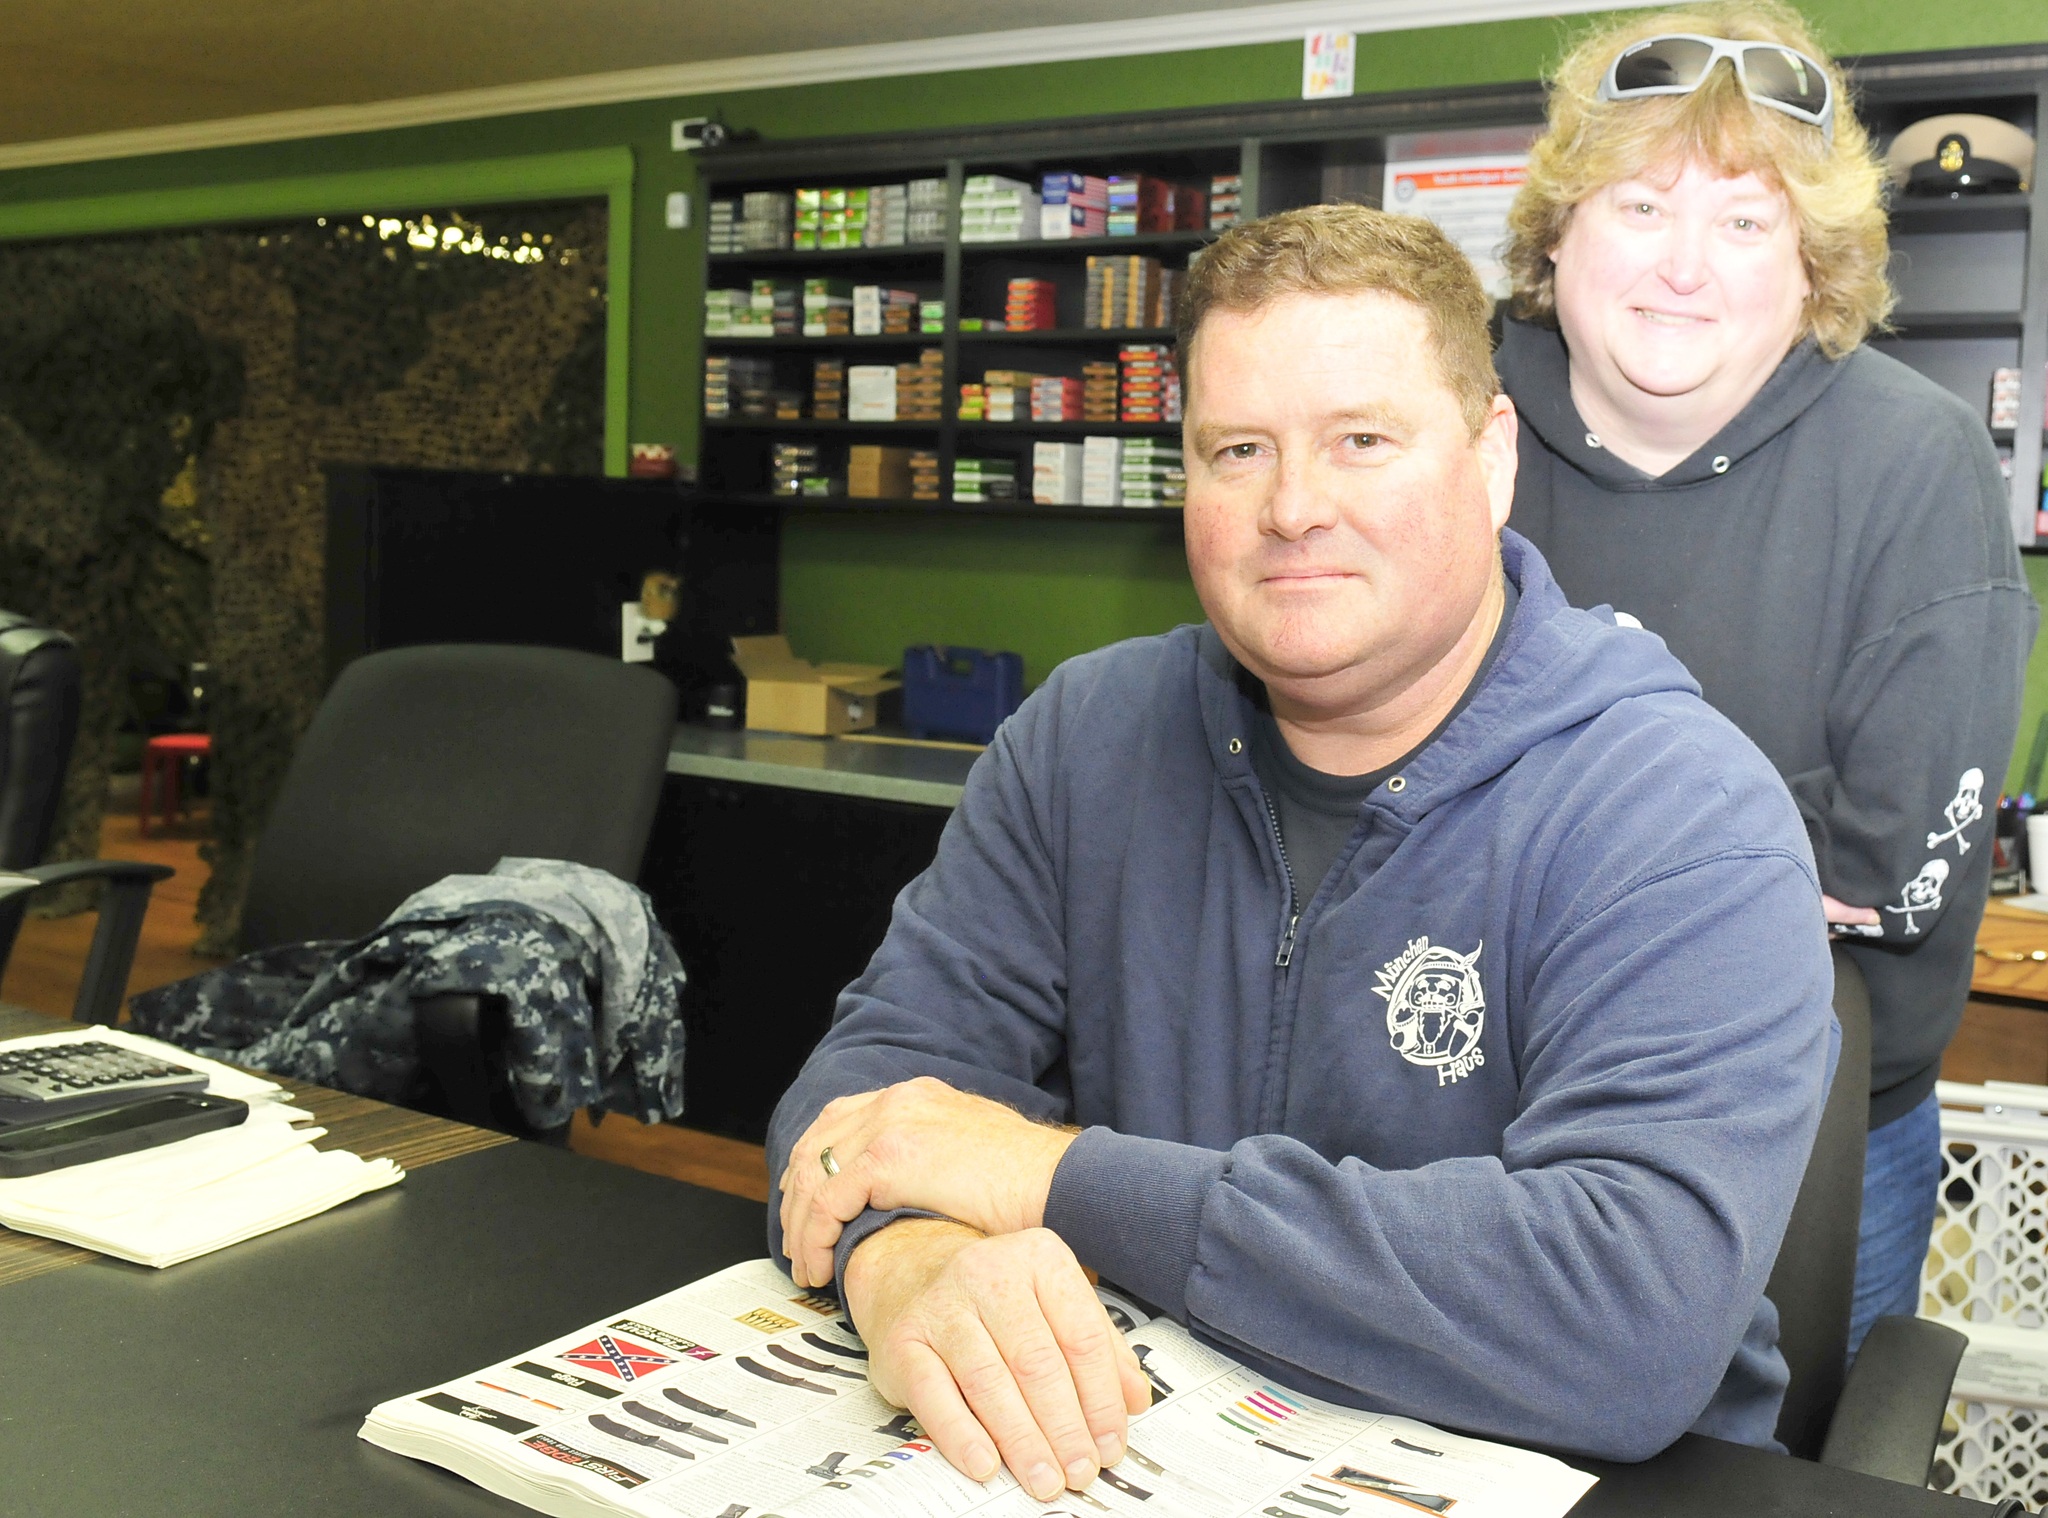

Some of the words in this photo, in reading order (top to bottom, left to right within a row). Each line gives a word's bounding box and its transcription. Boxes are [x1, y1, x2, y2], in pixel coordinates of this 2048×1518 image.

[1436, 1046, 1485, 1087] Haus
[613, 1323, 686, 1351] Flexcut
[550, 1371, 587, 1387] Flags
